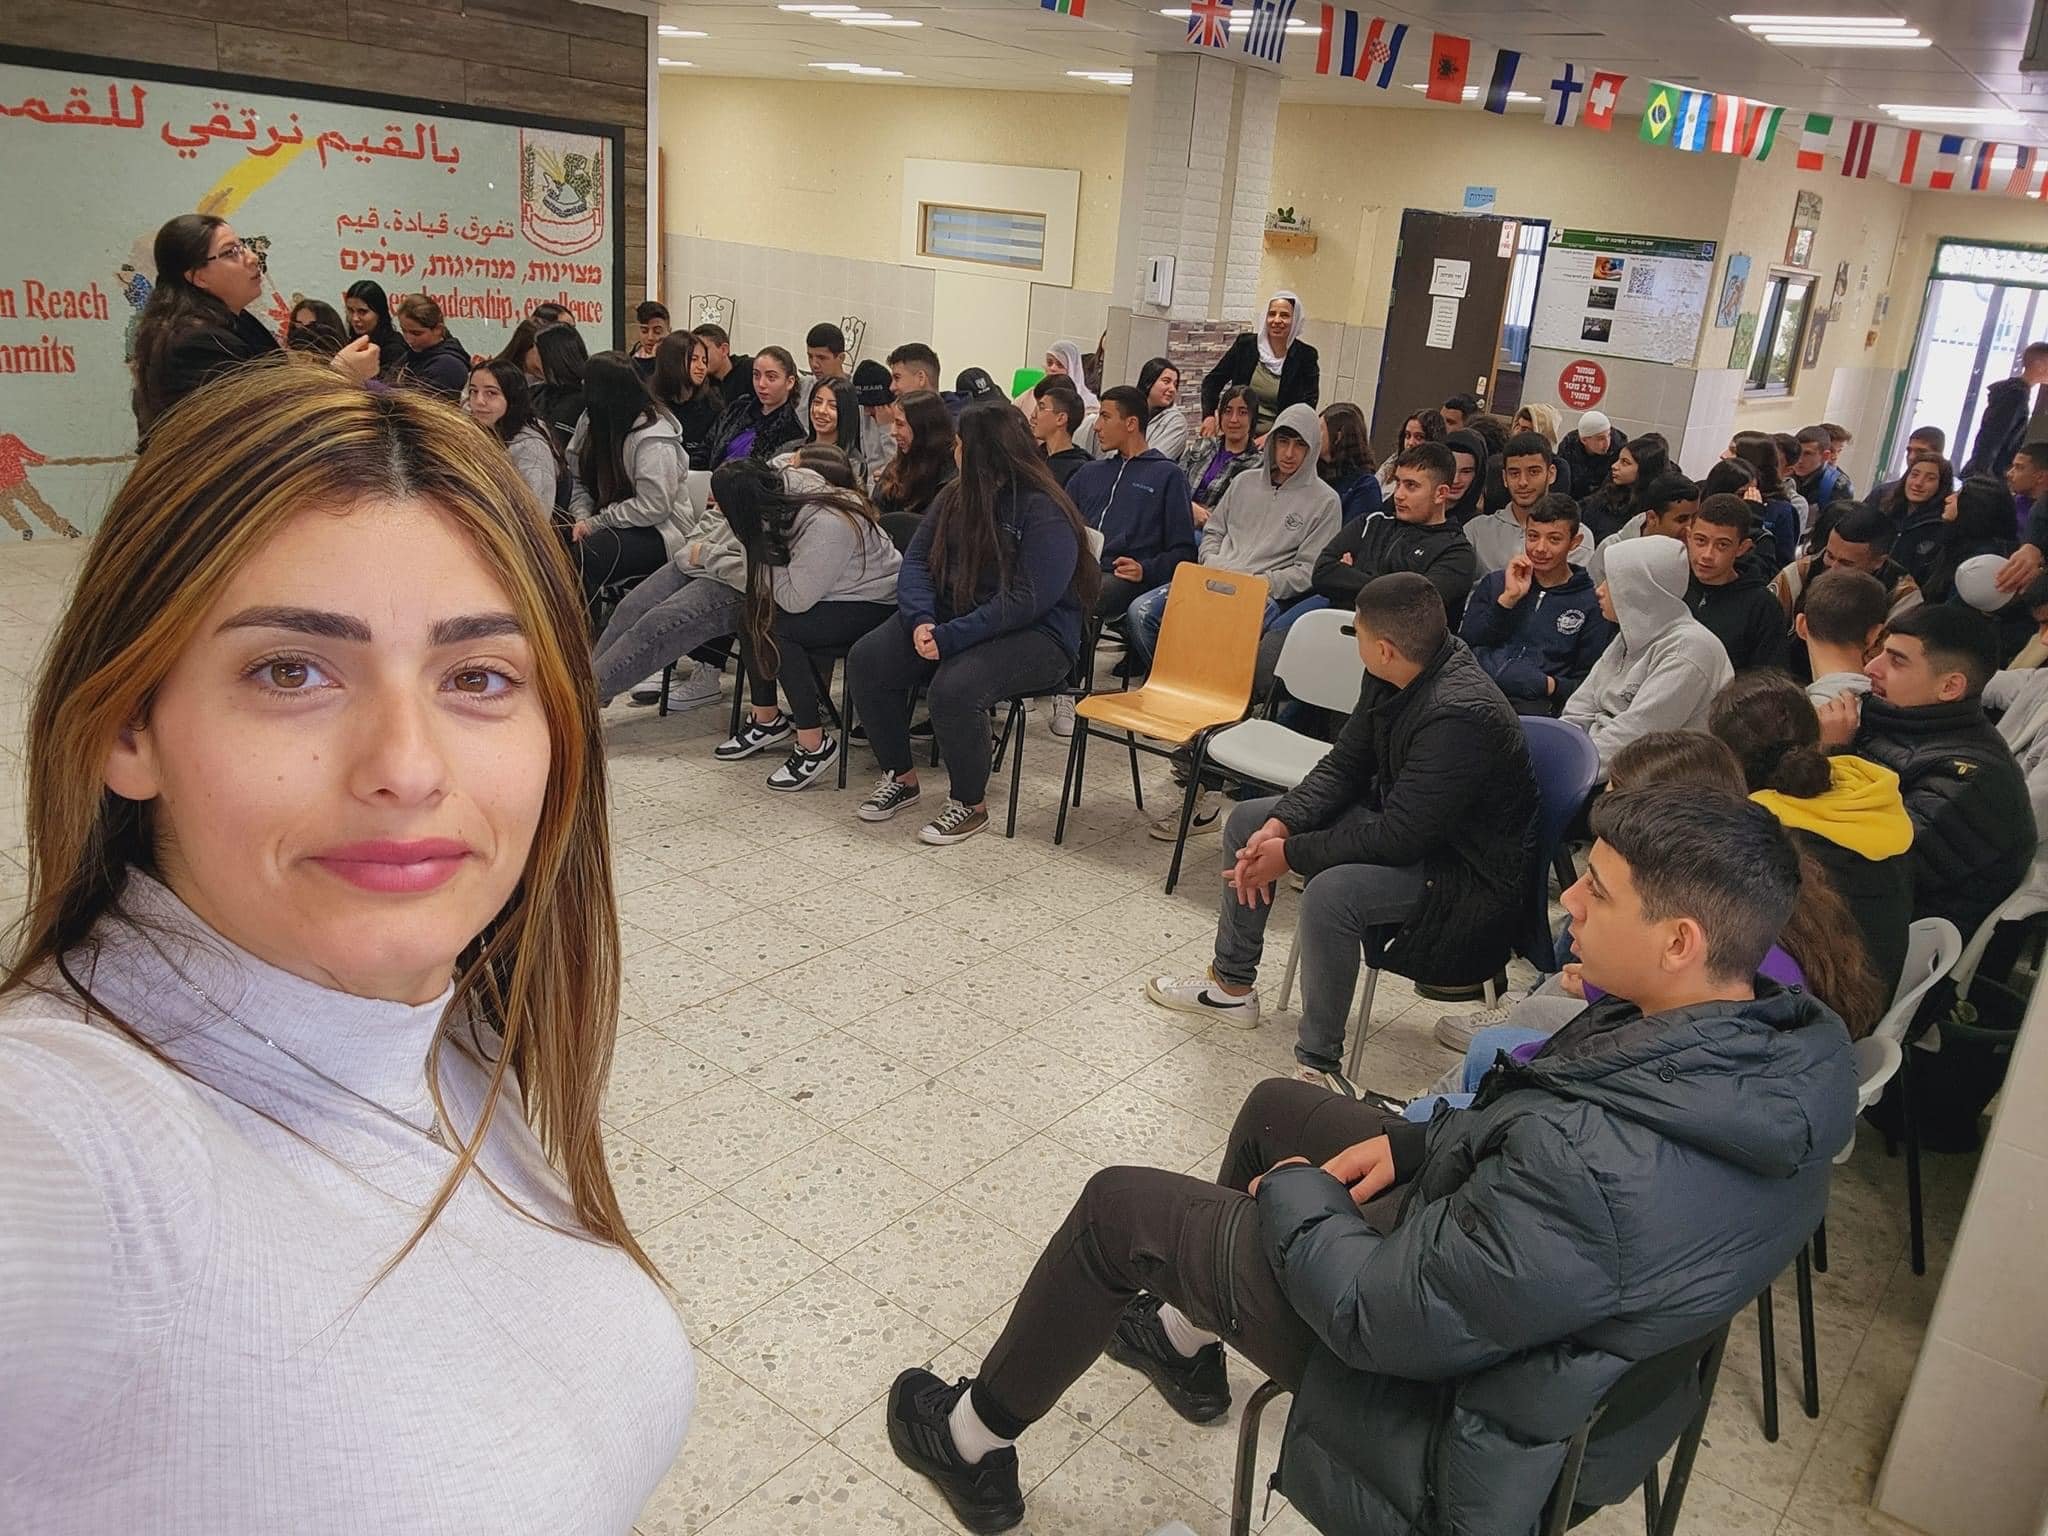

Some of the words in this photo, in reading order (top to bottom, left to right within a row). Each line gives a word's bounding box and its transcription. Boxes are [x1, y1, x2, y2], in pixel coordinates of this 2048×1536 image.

[0, 83, 147, 128] للقم
[161, 102, 304, 159] نرتقي
[316, 122, 460, 174] بالقيم
[337, 208, 379, 236] قيم
[340, 248, 415, 275] ערכים
[421, 254, 516, 280] מנהיגות,
[522, 258, 602, 285] מצוינות,
[23, 279, 109, 320] Reach
[1564, 382, 1580, 390] מטר
[1572, 374, 1595, 384] מרחק
[1588, 384, 1601, 393] של
